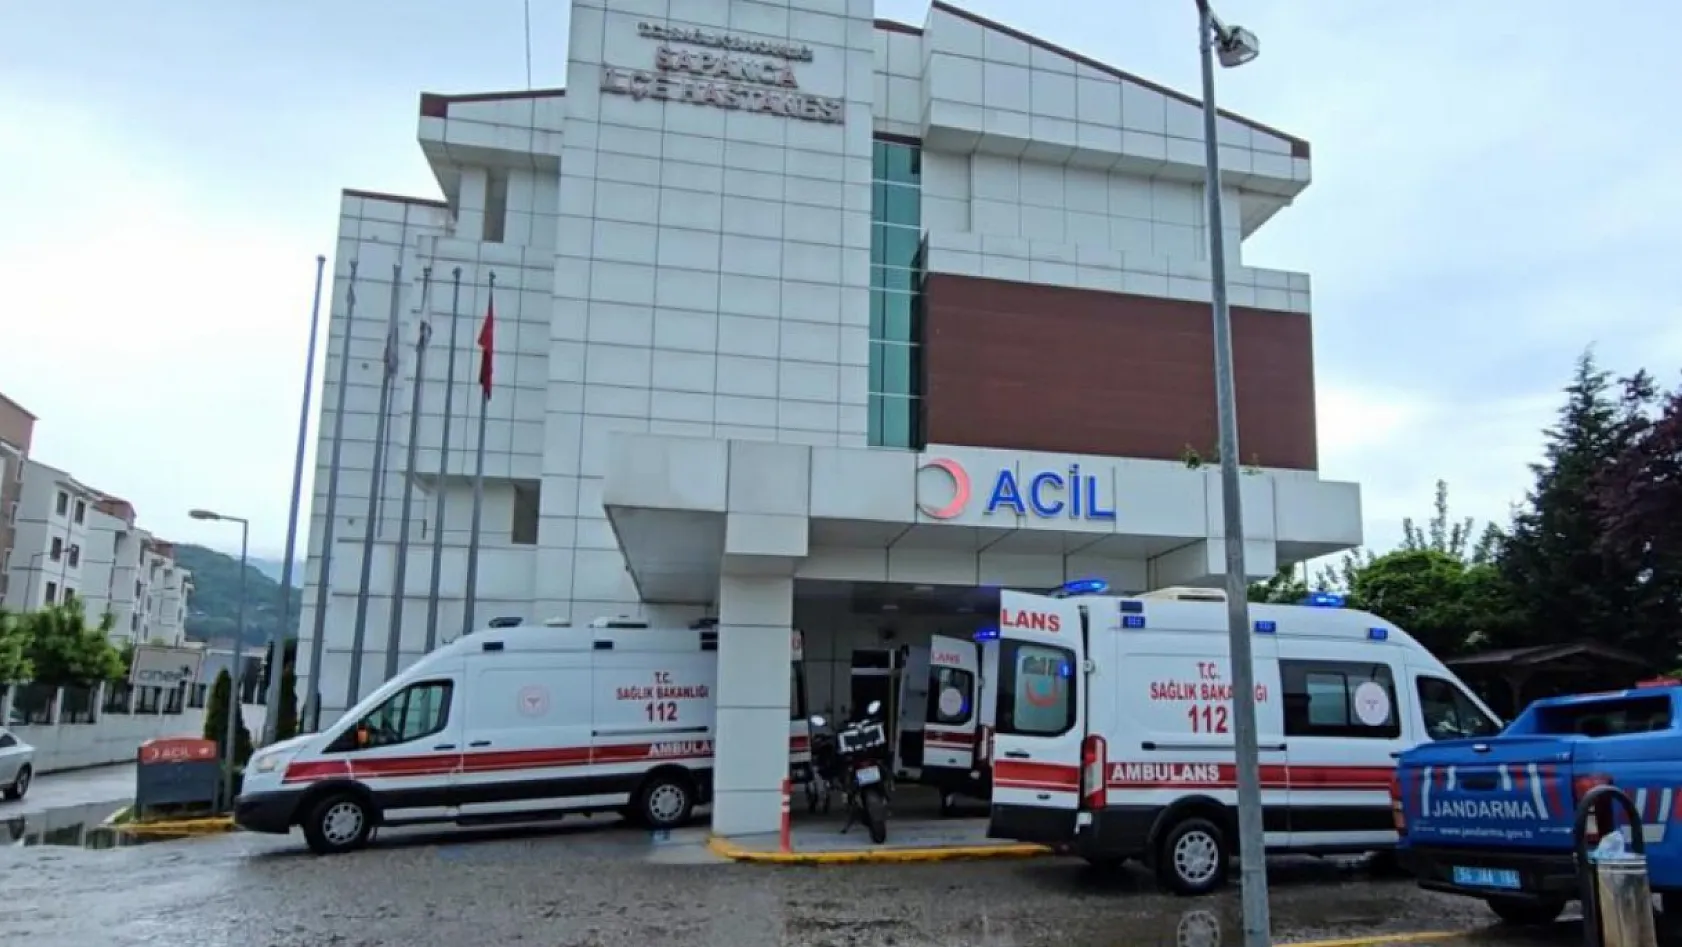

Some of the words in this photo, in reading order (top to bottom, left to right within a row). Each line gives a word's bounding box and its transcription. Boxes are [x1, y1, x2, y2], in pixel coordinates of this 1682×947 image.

[656, 45, 798, 88] SAPANCA
[985, 463, 1116, 520] ACİL
[1197, 661, 1221, 680] T.C.
[616, 685, 653, 701] SAĞLIK
[656, 684, 710, 699] BAKANLIĞI
[1149, 679, 1197, 700] SAĞLIK
[645, 700, 678, 723] 112
[1188, 704, 1229, 734] 112
[648, 739, 714, 758] AMBULA
[1111, 763, 1220, 781] AMBULANS
[1432, 800, 1537, 820] JANDARMA
